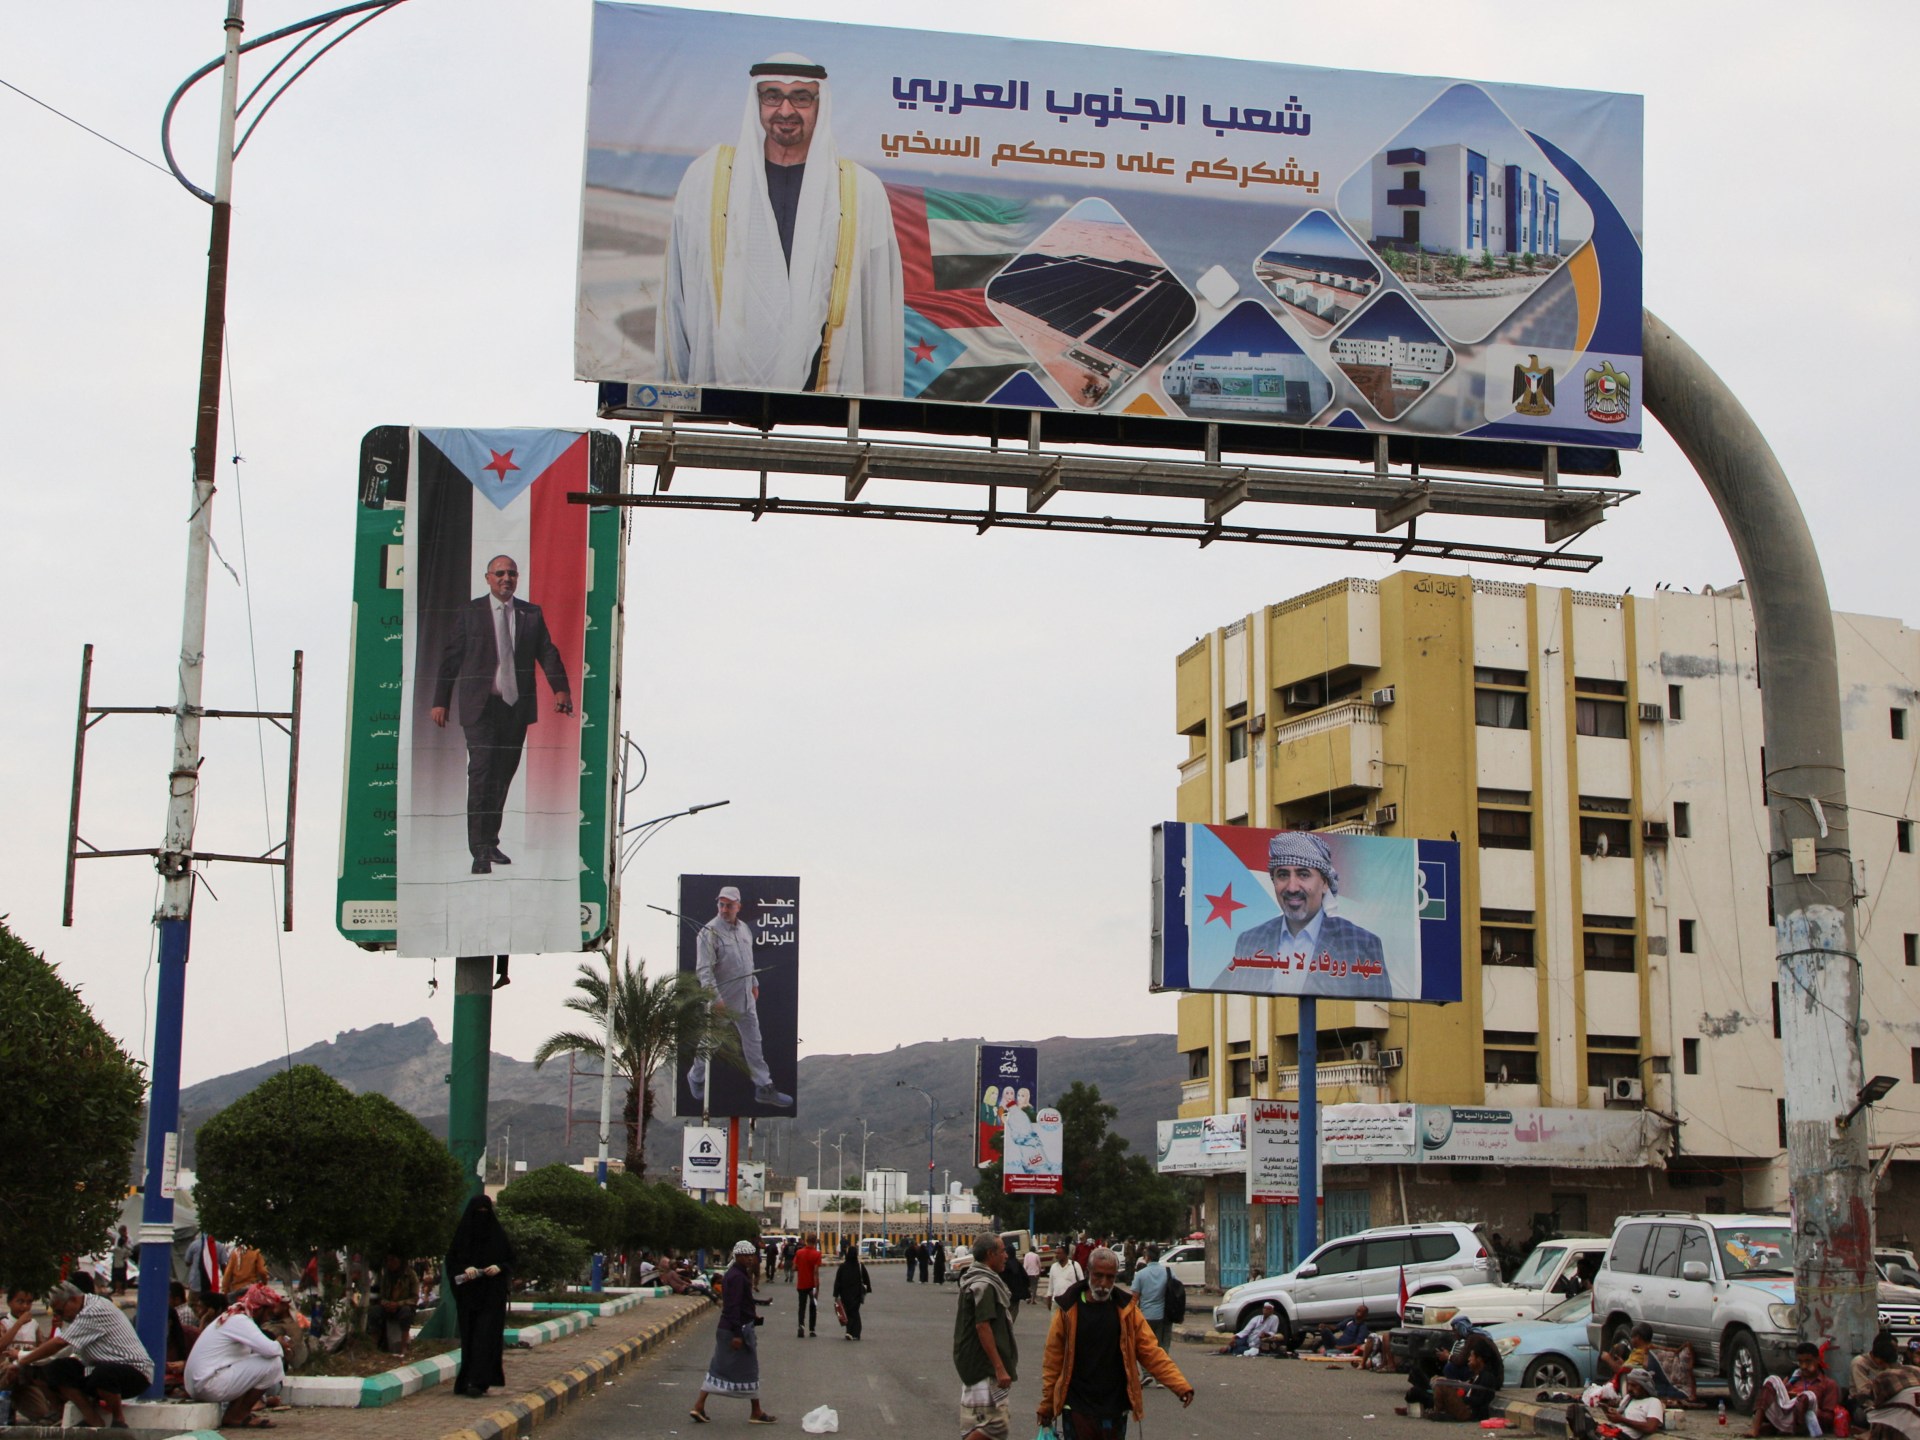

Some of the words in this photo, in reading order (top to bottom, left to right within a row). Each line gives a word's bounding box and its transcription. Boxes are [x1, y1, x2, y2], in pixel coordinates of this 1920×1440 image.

[892, 76, 1029, 115] العربي
[1046, 87, 1186, 131] الجنوب
[1202, 95, 1312, 137] شعب
[880, 130, 980, 158] السخي
[991, 140, 1106, 169] دعمكم
[1116, 151, 1175, 176] على
[1185, 156, 1320, 194] يشكركم
[757, 897, 795, 907] عهد
[756, 912, 794, 928] الرجال
[755, 930, 795, 946] للرجال
[1227, 949, 1290, 975] ينكسر
[1293, 951, 1306, 971] لا
[1309, 950, 1348, 977] ووفاء
[1351, 957, 1383, 980] عهد
